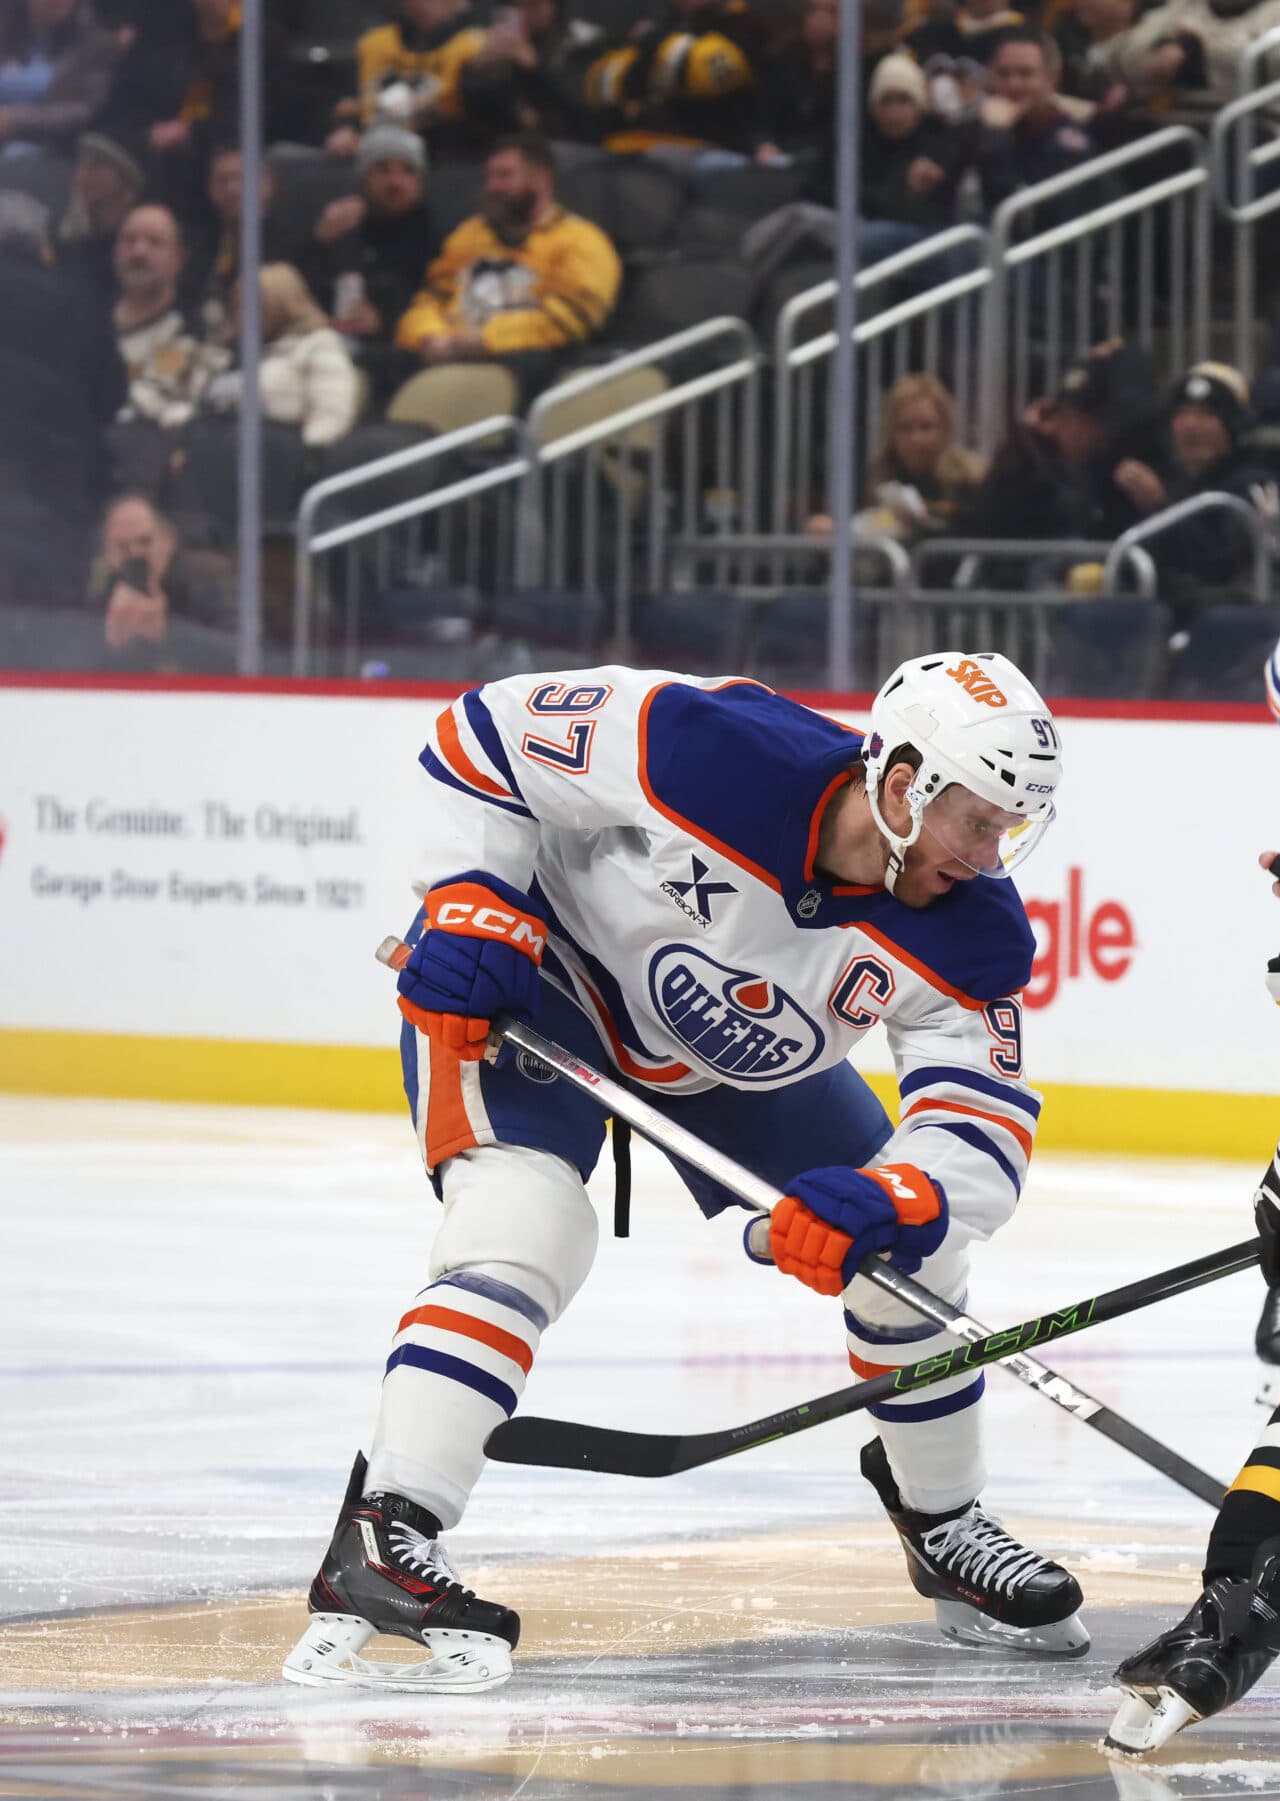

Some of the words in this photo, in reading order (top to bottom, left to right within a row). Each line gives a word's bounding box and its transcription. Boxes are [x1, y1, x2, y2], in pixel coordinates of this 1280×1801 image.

[945, 660, 1008, 708] SKIP
[521, 682, 614, 775] 97
[1031, 718, 1058, 750] 97
[35, 795, 77, 833] The
[204, 799, 247, 838] The
[31, 864, 104, 907] Garage
[111, 868, 160, 897] Door
[168, 871, 247, 910] Experts
[253, 875, 307, 905] Since
[659, 882, 709, 929] KARBON-X
[436, 902, 544, 956] CCM
[827, 954, 896, 1030] C
[662, 963, 803, 1073] OILERS
[895, 1297, 1097, 1392] CCM
